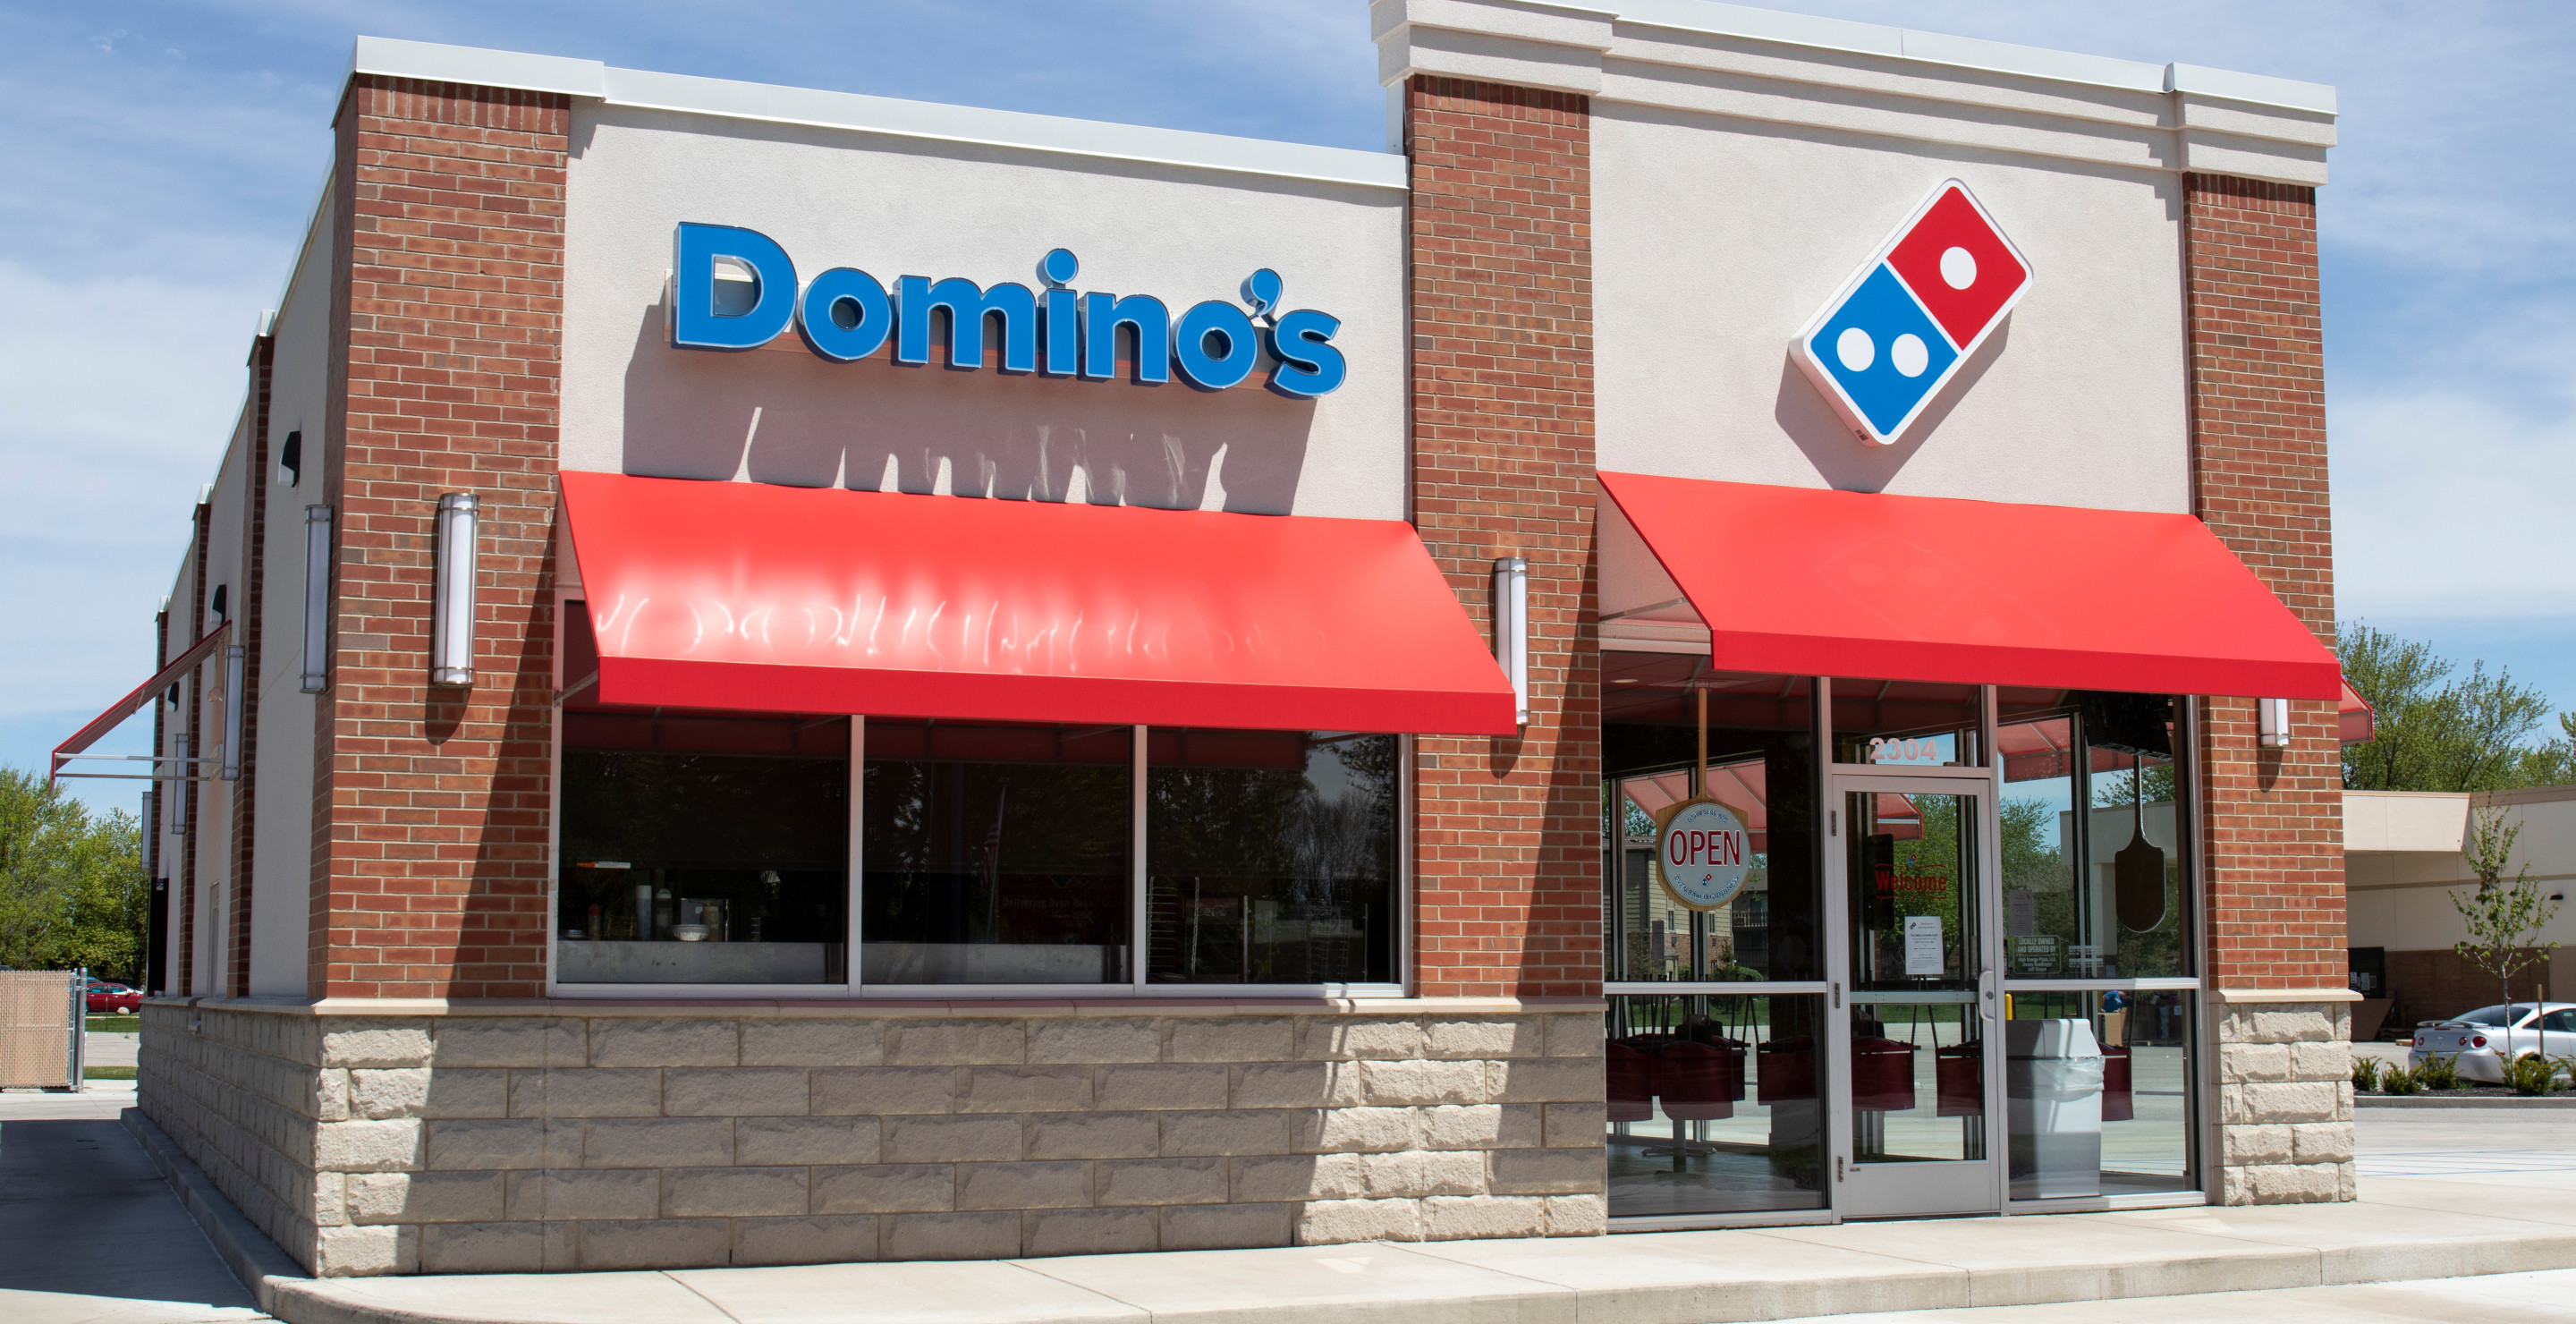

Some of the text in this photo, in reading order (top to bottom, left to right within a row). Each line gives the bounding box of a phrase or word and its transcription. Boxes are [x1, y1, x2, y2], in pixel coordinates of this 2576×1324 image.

[672, 221, 1347, 397] Domino's
[1869, 737, 1936, 760] 2304
[1686, 809, 1727, 823] NOW SERVING
[1669, 828, 1741, 867] OPEN
[1674, 875, 1739, 900] OVEN BAKED GOODNESS
[1875, 870, 1947, 892] Welcome
